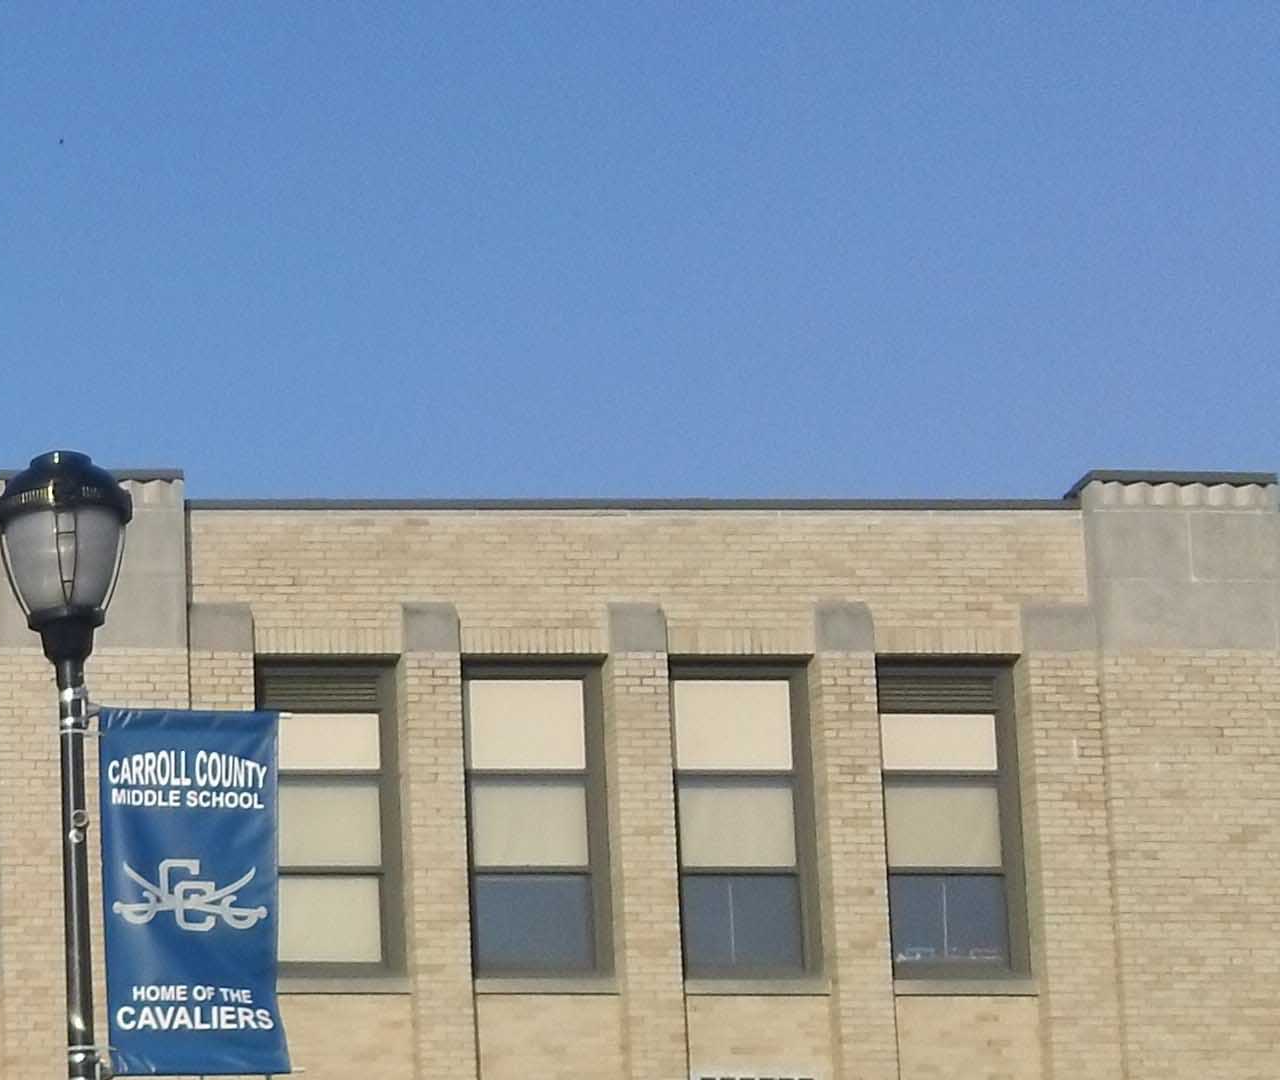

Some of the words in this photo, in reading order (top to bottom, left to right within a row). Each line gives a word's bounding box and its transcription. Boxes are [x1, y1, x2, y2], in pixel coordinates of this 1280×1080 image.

[108, 750, 191, 786] CARROLL
[195, 750, 267, 788] COUNTY
[112, 788, 181, 806] MIDDLE
[186, 791, 264, 809] SCHOOL
[132, 985, 187, 1001] HOME
[192, 985, 215, 1001] OF
[219, 987, 253, 1004] THE
[116, 1006, 274, 1030] CAVALIERS
